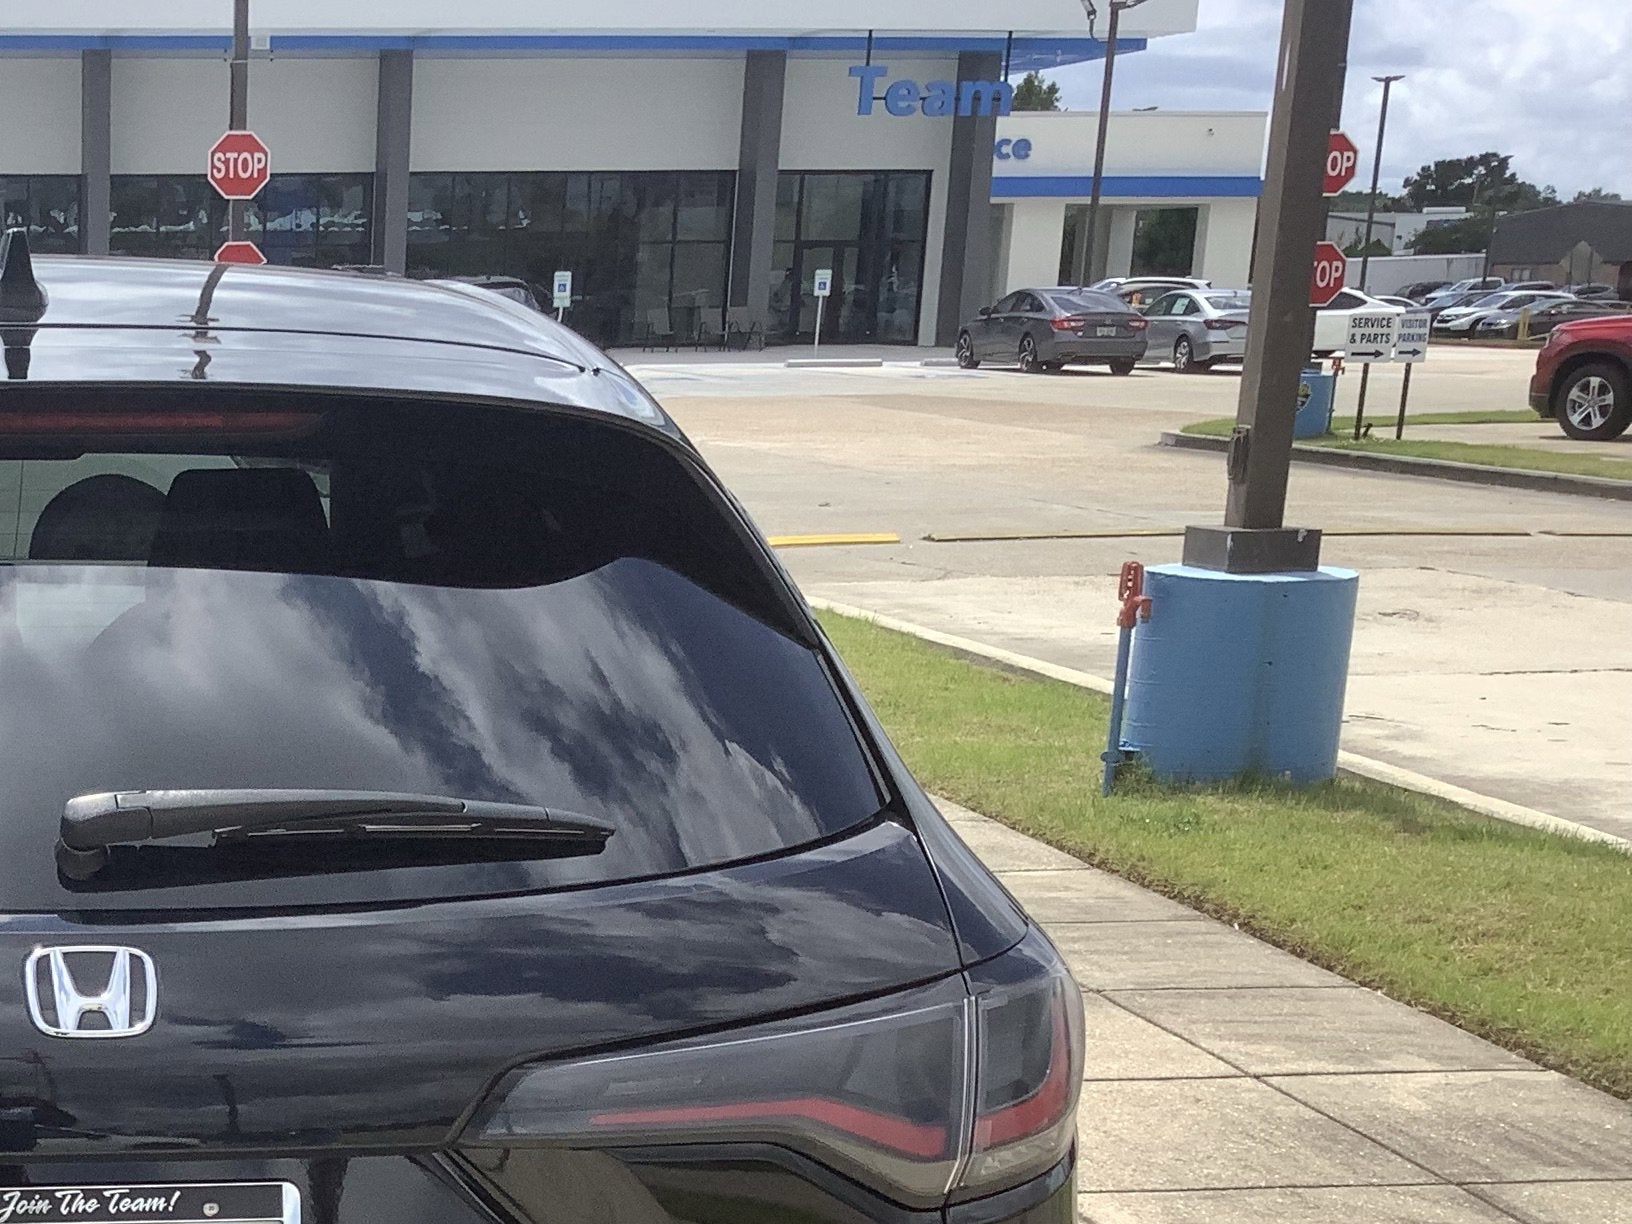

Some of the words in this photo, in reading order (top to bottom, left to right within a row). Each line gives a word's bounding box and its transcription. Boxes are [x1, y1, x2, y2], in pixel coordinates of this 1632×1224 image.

[848, 65, 1013, 117] Team
[213, 152, 266, 179] STOP
[1327, 151, 1355, 176] OP
[1314, 261, 1343, 288] OP
[1351, 317, 1392, 329] SERVICE
[1349, 332, 1357, 344] &
[1360, 332, 1391, 344] PARTS
[1398, 332, 1427, 343] PARKING
[54, 1190, 101, 1215] The
[103, 1189, 182, 1214] Team!
